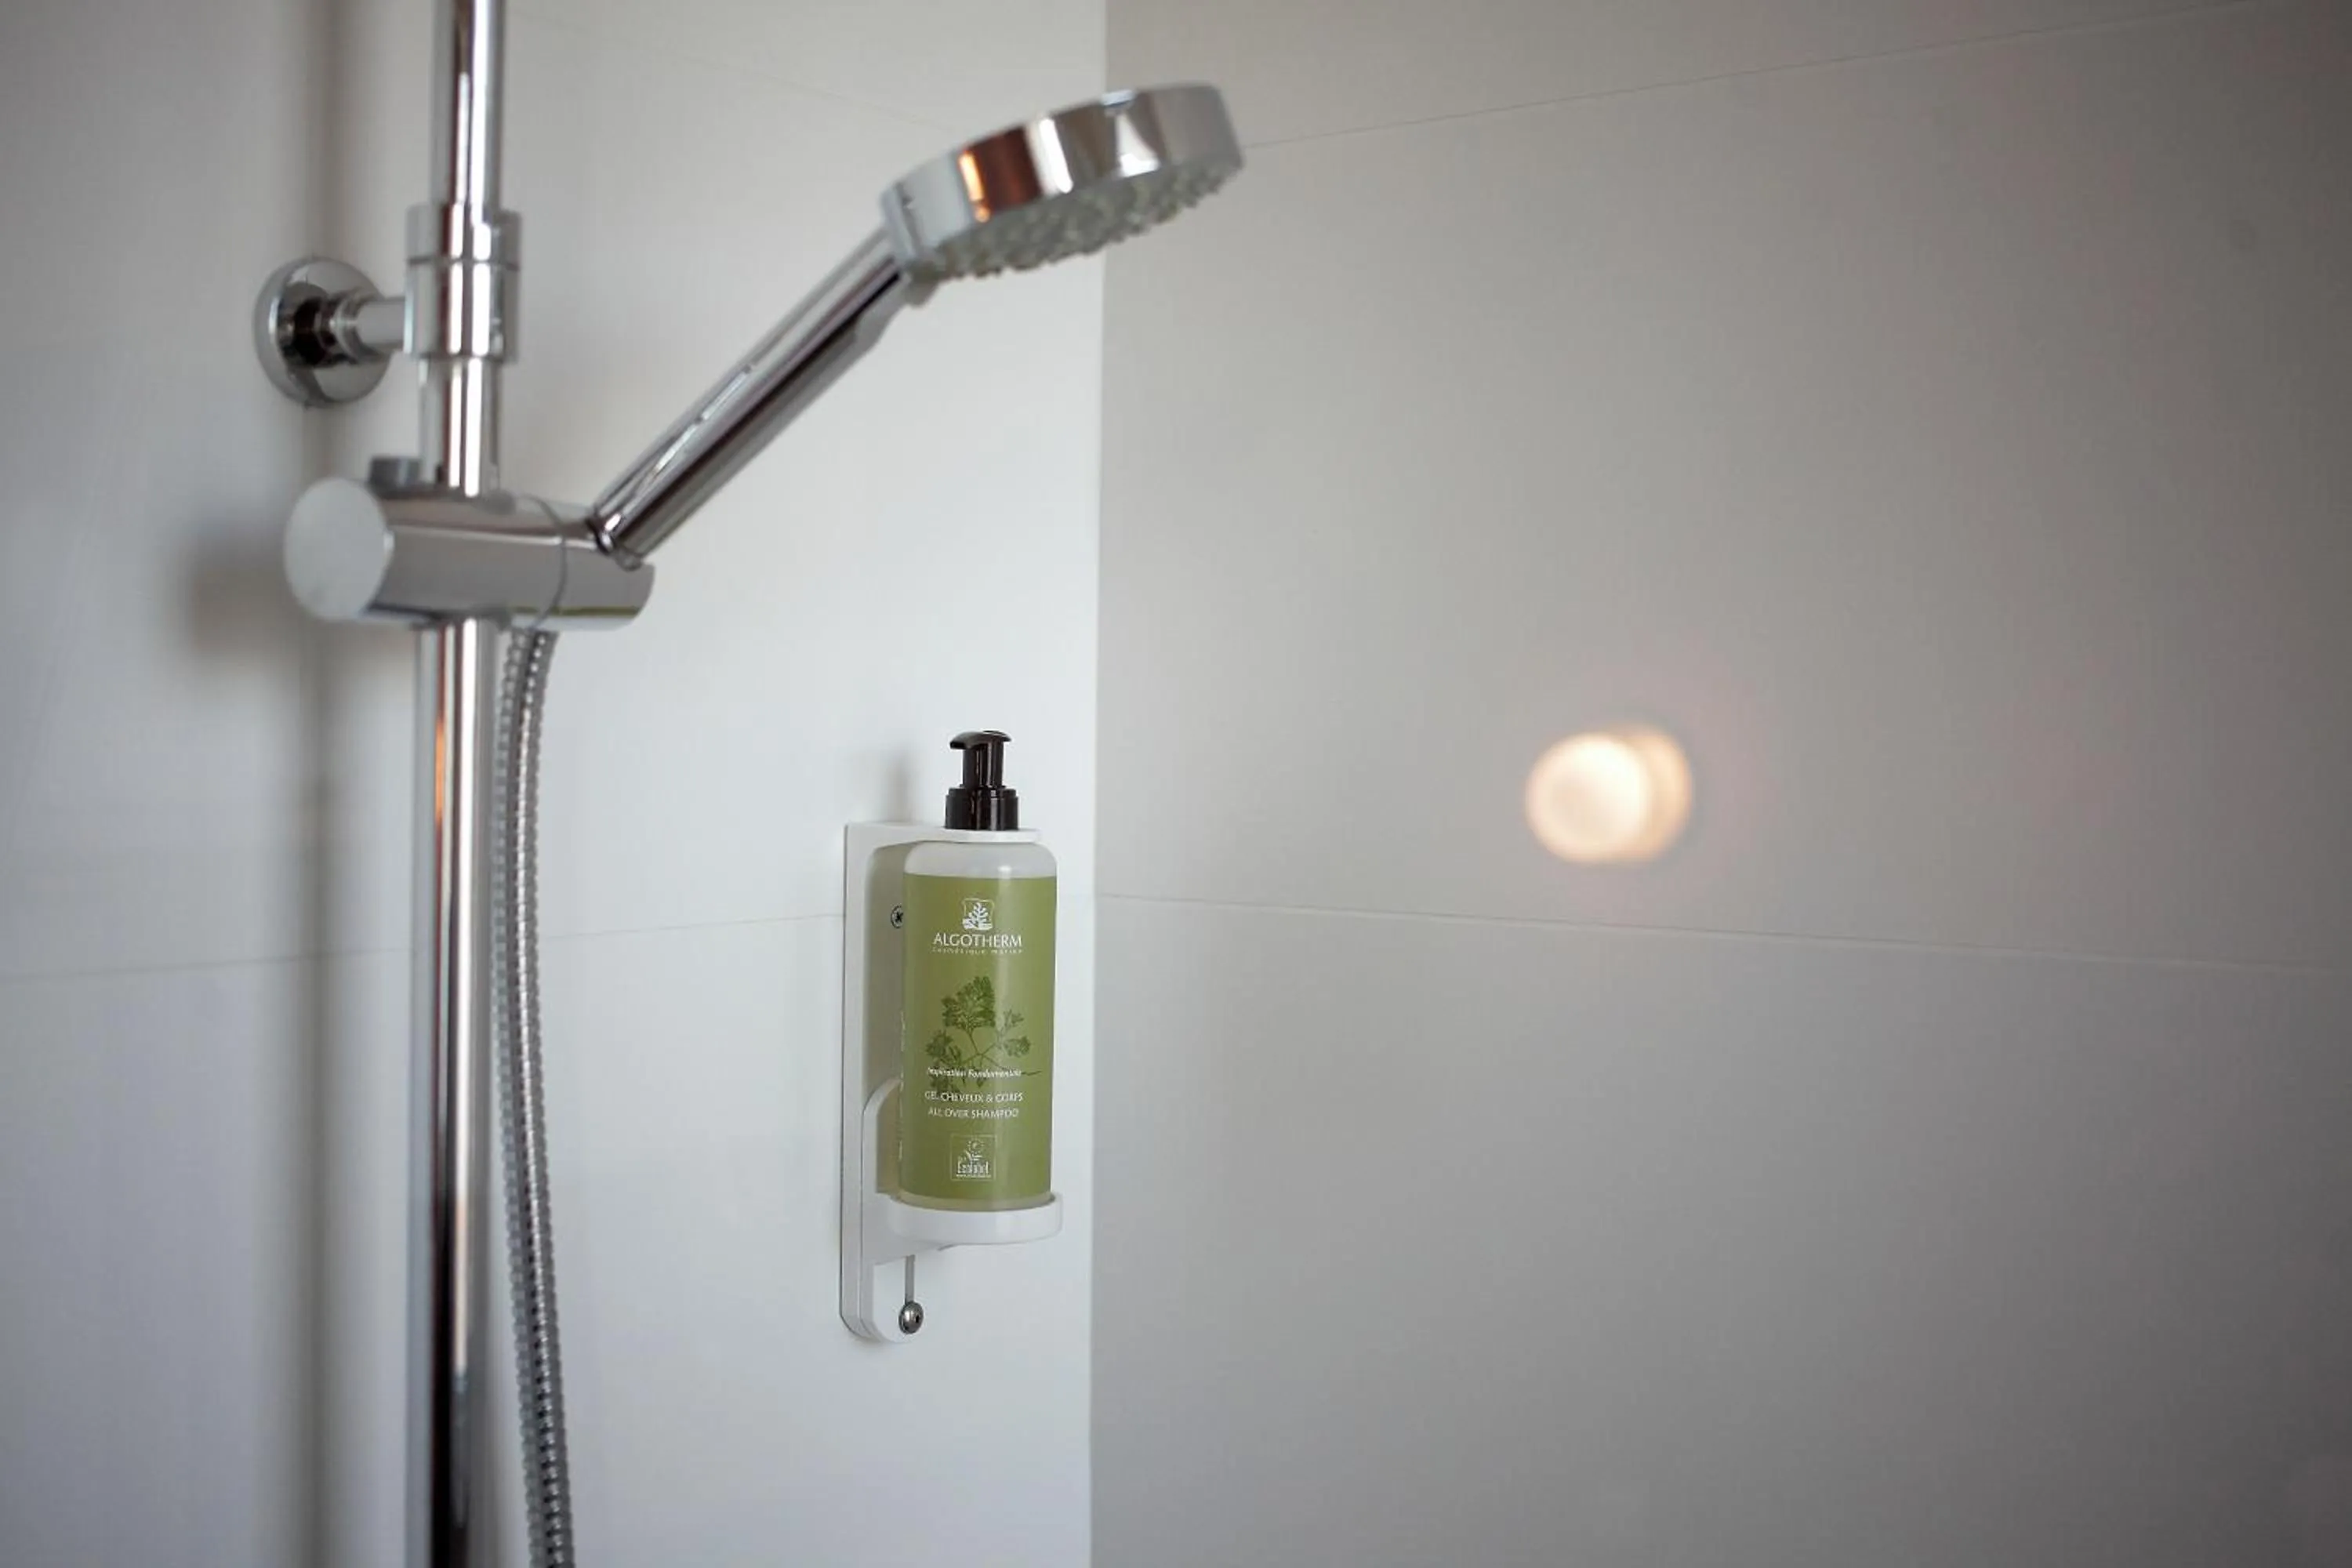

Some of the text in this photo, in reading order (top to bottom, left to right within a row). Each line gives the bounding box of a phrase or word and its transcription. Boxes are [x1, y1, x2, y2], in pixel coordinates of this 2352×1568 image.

[933, 932, 1022, 947] ALGOTHERM
[924, 1091, 1023, 1103] GEL CHEVEUX & CORPS
[927, 1106, 1019, 1120] ALL OVER SHAMPOO
